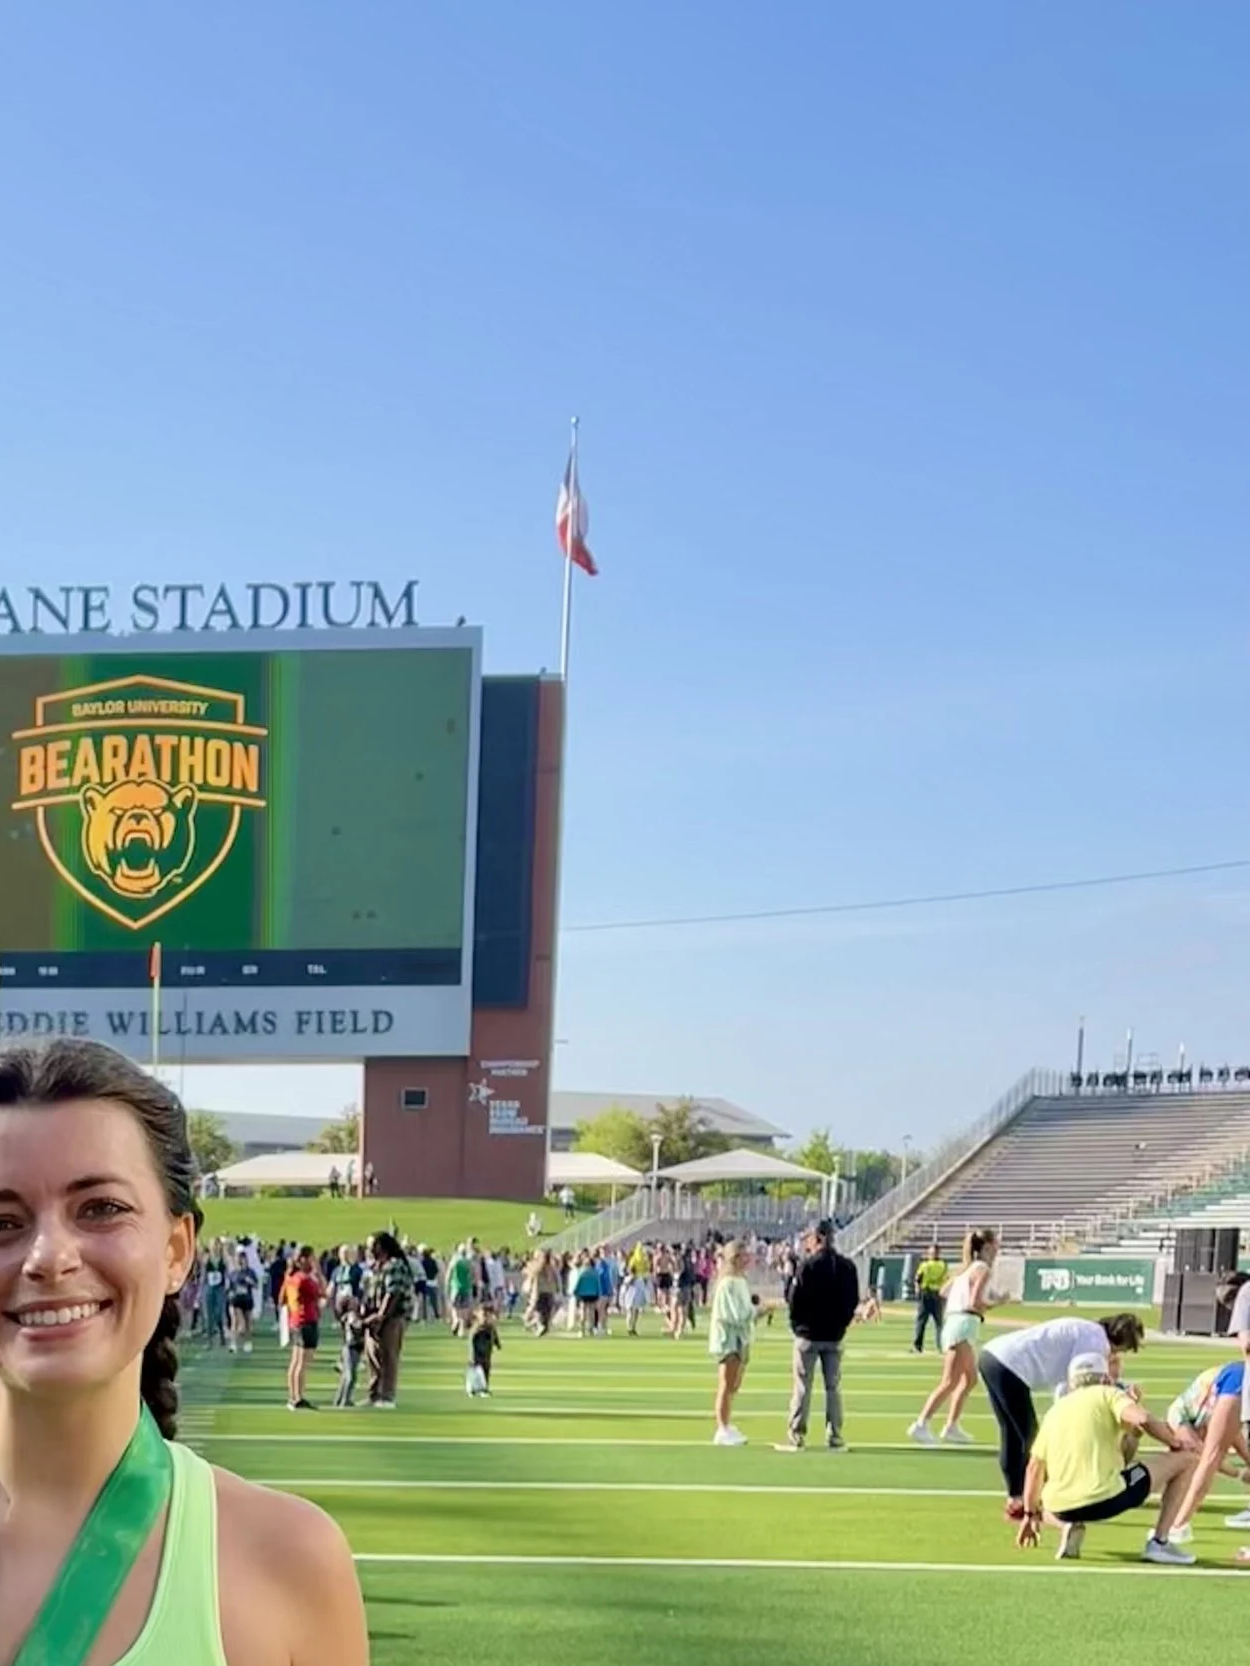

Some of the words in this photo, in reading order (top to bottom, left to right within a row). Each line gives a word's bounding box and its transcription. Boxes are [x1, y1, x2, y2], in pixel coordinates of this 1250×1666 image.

[131, 580, 419, 631] STADIUM
[72, 701, 125, 716] BAYLOR
[128, 700, 210, 715] UNIVERSITY
[20, 734, 259, 795] BEARATHON
[295, 1010, 394, 1034] FIELD
